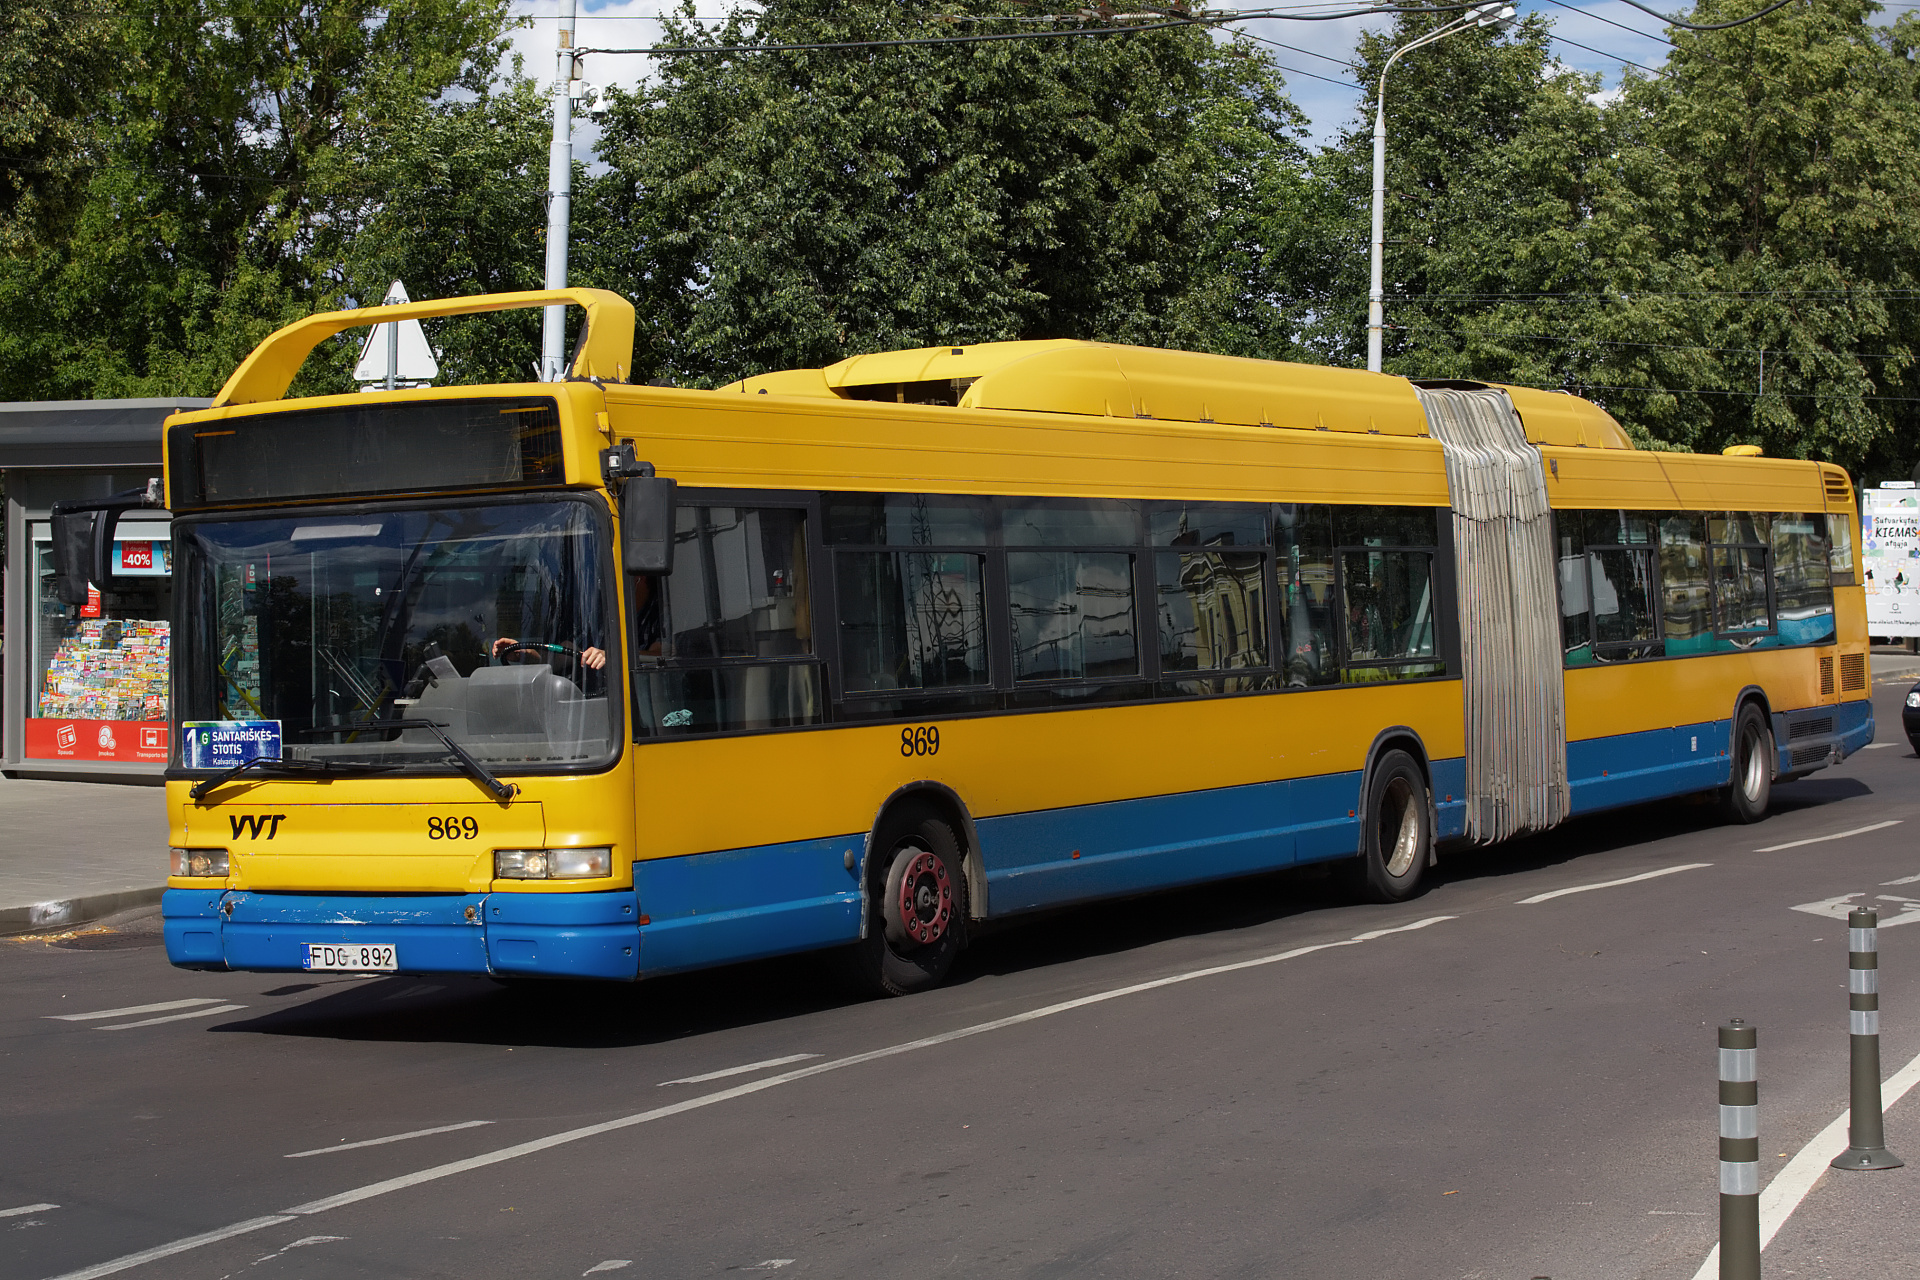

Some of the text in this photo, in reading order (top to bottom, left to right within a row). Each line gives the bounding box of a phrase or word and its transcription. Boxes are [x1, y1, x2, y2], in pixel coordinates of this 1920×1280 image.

[1875, 516, 1918, 526] Sutvarkytas
[1875, 526, 1918, 538] KIEMAS
[123, 553, 151, 566] -40%
[187, 728, 197, 768] 1
[212, 743, 243, 755] STOTIS
[901, 725, 940, 757] 869
[427, 816, 479, 840] 869
[360, 947, 394, 967] 892
